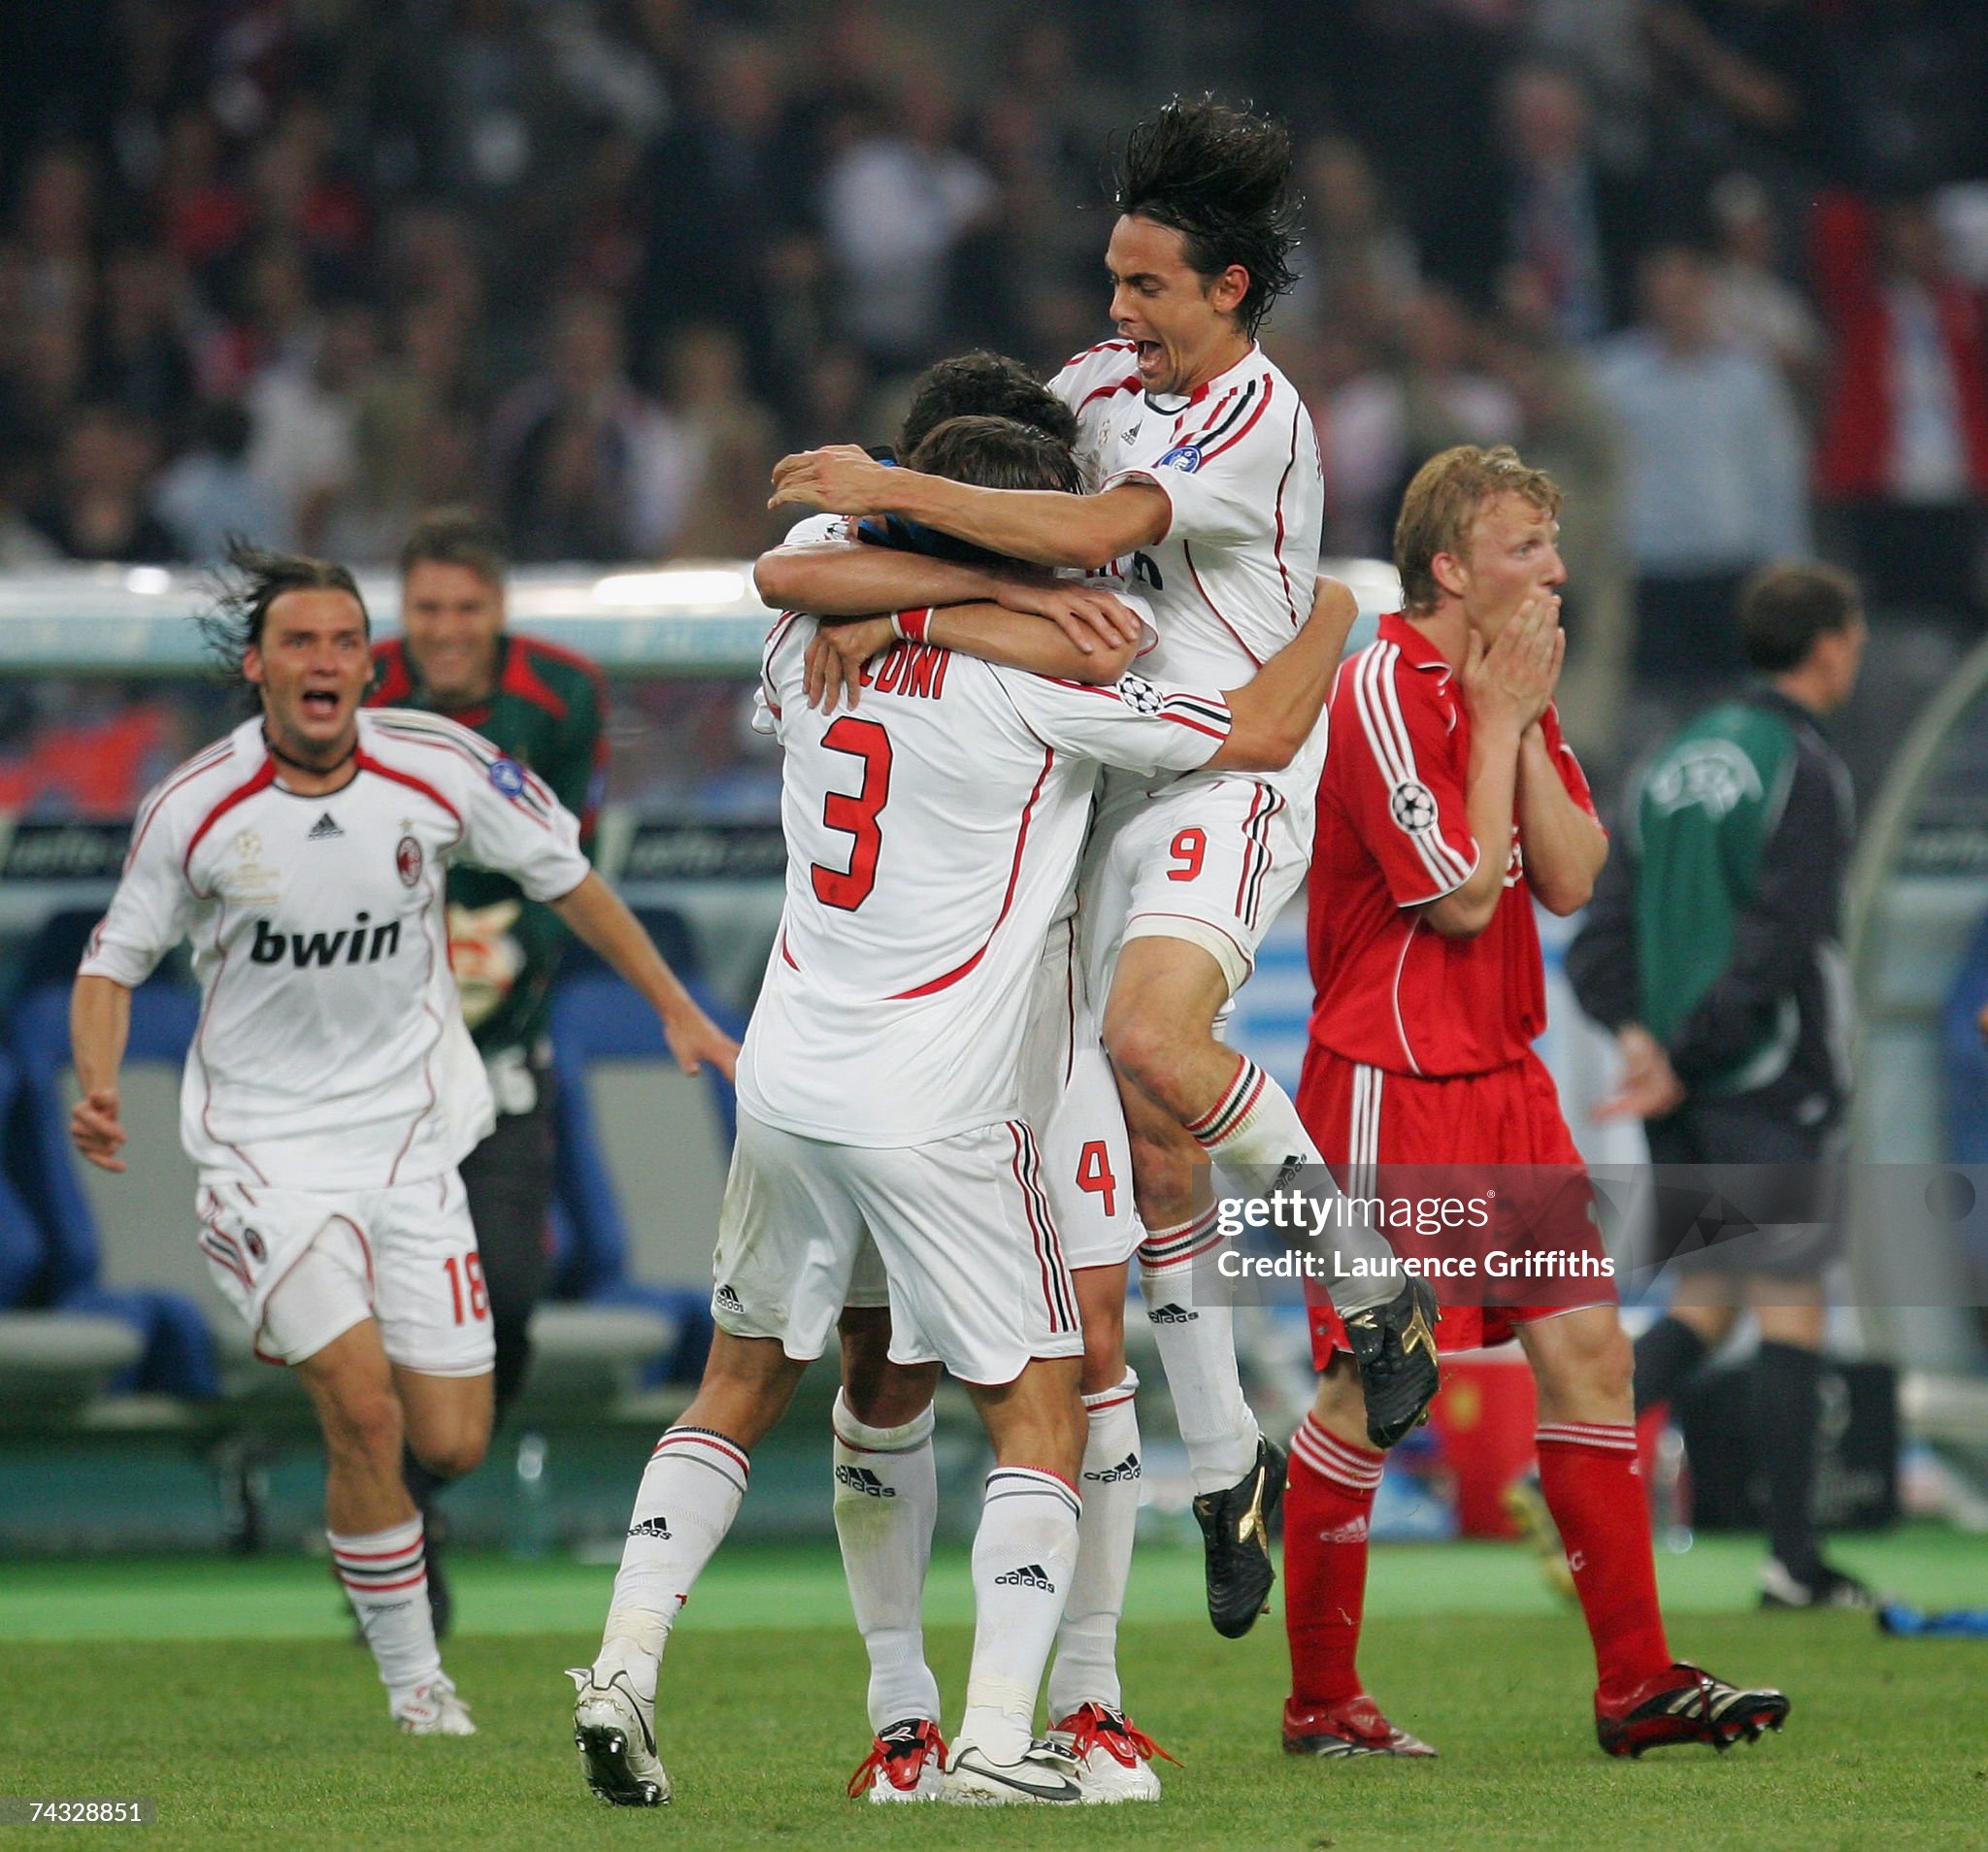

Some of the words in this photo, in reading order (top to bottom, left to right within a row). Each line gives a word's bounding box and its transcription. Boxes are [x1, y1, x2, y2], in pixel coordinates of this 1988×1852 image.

[859, 638, 951, 700] LDINI
[811, 715, 893, 911] 3
[1166, 827, 1207, 881] 9
[250, 911, 401, 967] bwin
[1076, 1141, 1116, 1217] 4
[445, 1252, 487, 1327] 18
[1147, 1310, 1199, 1324] didas
[1082, 1464, 1141, 1483] adida
[995, 1571, 1055, 1593] adidas
